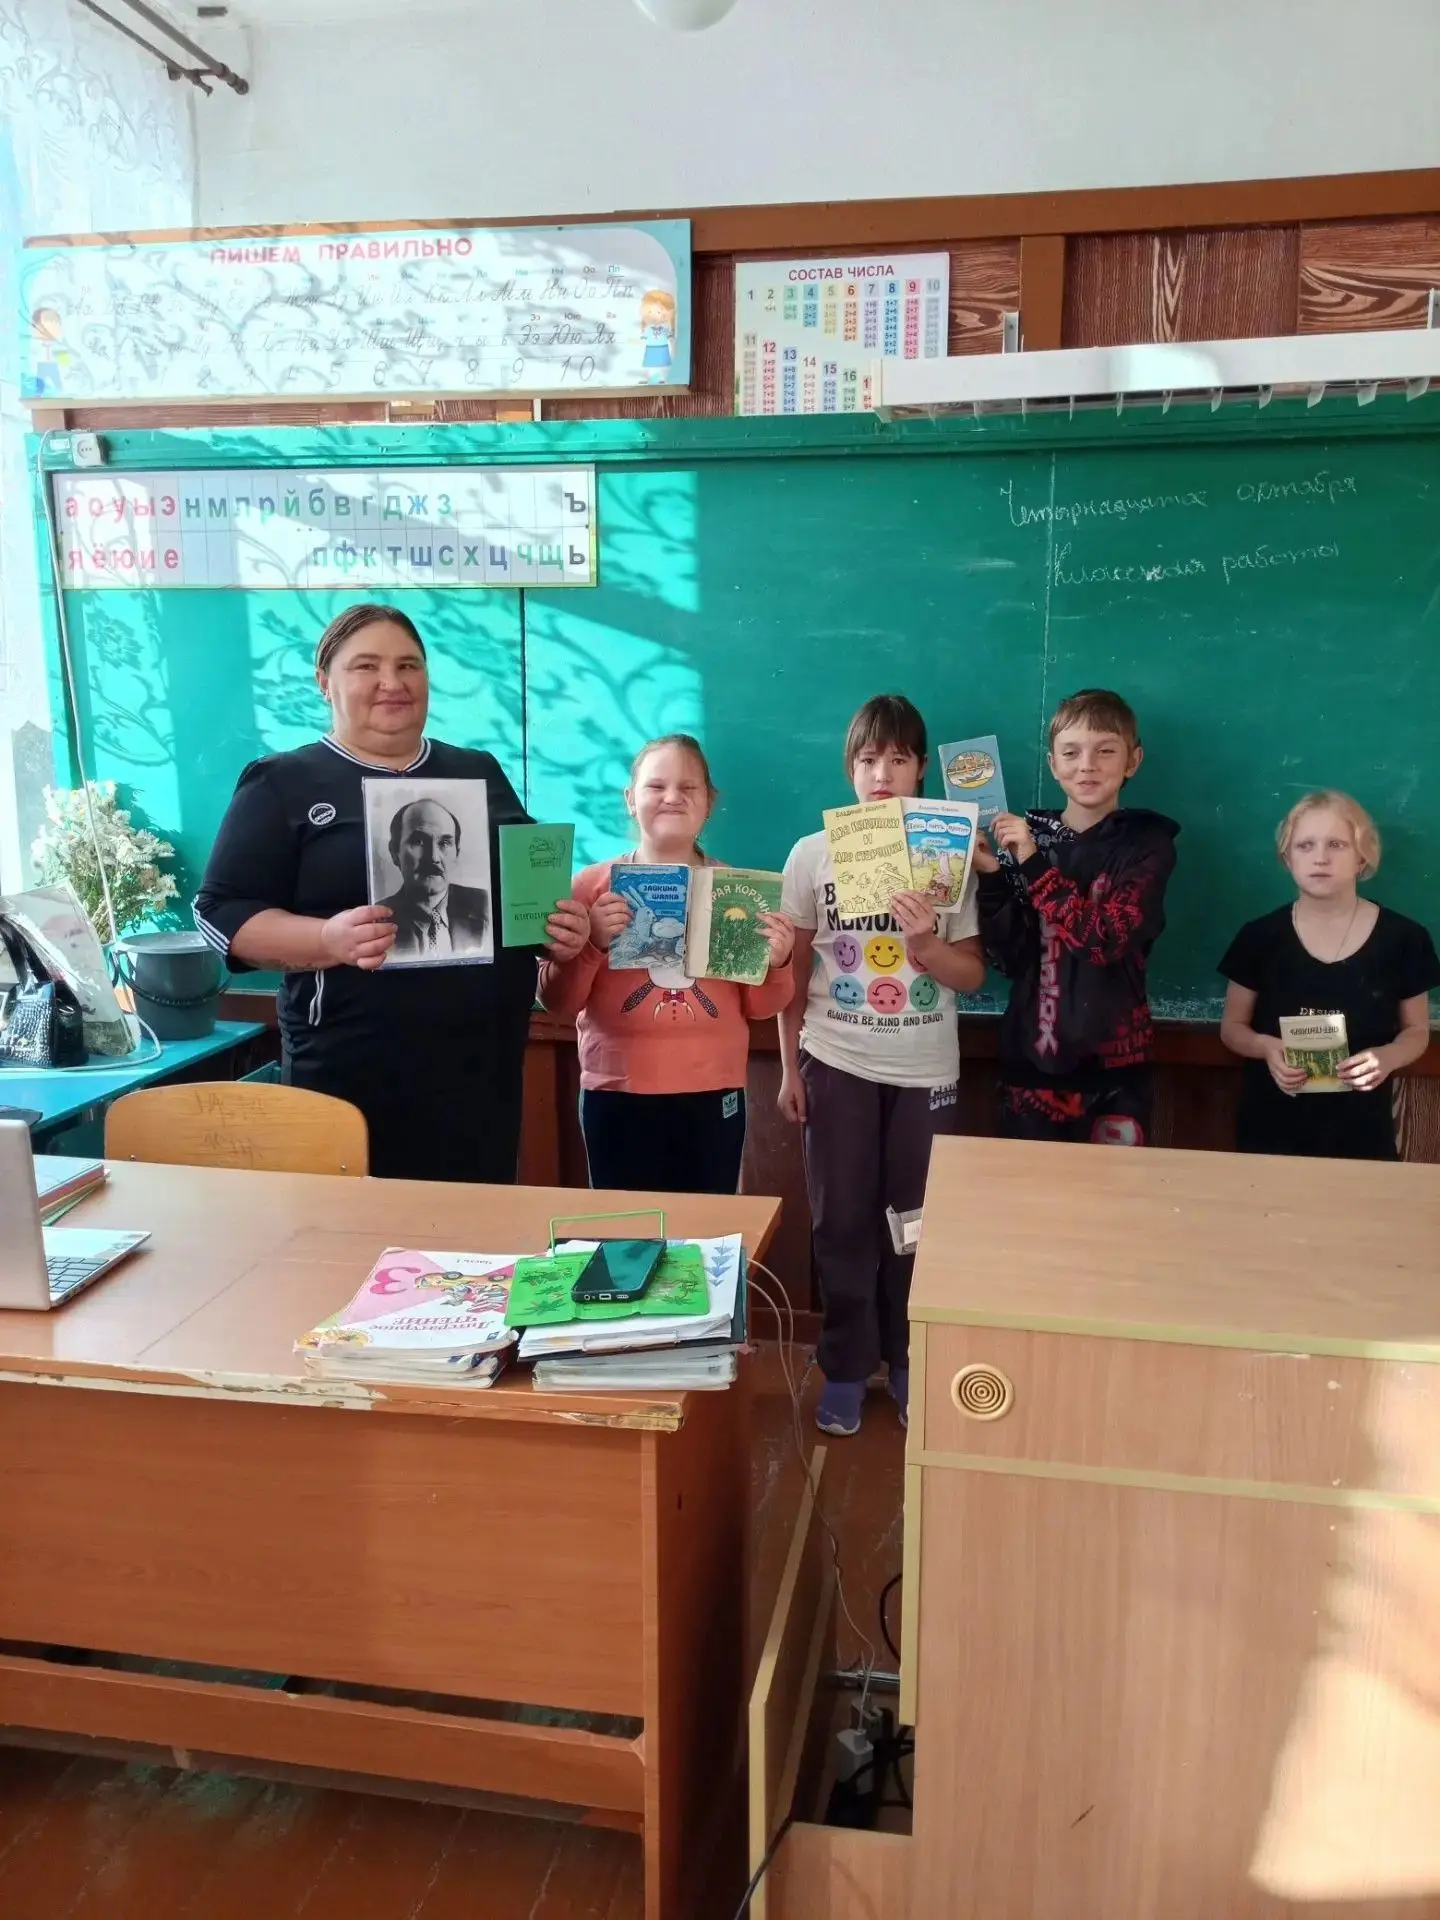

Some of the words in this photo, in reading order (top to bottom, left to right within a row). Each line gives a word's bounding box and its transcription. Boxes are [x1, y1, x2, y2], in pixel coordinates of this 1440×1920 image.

[209, 246, 301, 265] ПИШЕМ
[318, 238, 473, 261] ПРАВИЛЬНО
[788, 268, 843, 281] СОСТАВ
[848, 264, 895, 276] ЧИСЛА
[748, 290, 754, 300] 1
[767, 289, 774, 299] 2
[787, 288, 794, 298] 3
[807, 288, 814, 297] 4
[828, 286, 835, 296] 5
[848, 286, 854, 296] 6
[868, 284, 875, 294] 7
[888, 283, 895, 293] 8
[909, 282, 916, 292] 9
[927, 280, 940, 290] 10
[745, 336, 756, 345] 11
[763, 342, 776, 353] 12
[783, 350, 796, 360] 13
[803, 356, 816, 368] 14
[824, 364, 837, 374] 15
[843, 370, 856, 382] 16
[864, 378, 871, 388] 1
[88, 496, 101, 517] о
[112, 495, 126, 523] у
[134, 496, 156, 517] ы
[160, 495, 176, 516] э
[185, 498, 201, 518] н
[208, 497, 228, 518] м
[259, 496, 275, 524] р
[284, 488, 300, 516] й
[308, 488, 326, 516] б
[334, 495, 350, 516] в
[362, 495, 375, 516] г
[383, 495, 403, 520] д
[407, 494, 428, 515] ж
[437, 494, 451, 515] з
[68, 549, 83, 569] я
[109, 549, 136, 569] ю
[140, 549, 156, 569] и
[163, 548, 179, 569] е
[313, 547, 328, 567] п
[333, 539, 357, 573] ф
[364, 546, 377, 567] к
[387, 546, 402, 566] т
[410, 545, 432, 567] ш
[438, 545, 454, 566] с
[463, 545, 480, 567] х
[490, 545, 508, 571] ц
[517, 544, 532, 565] ч
[539, 544, 564, 570] щ
[735, 883, 771, 914] КОРЗИН
[827, 1009, 859, 1025] ALWAYS
[861, 1015, 874, 1026] BE
[877, 1017, 900, 1027] KIND
[903, 1016, 920, 1027] AND
[922, 1012, 944, 1025] ENJOY
[369, 1266, 422, 1295] 3
